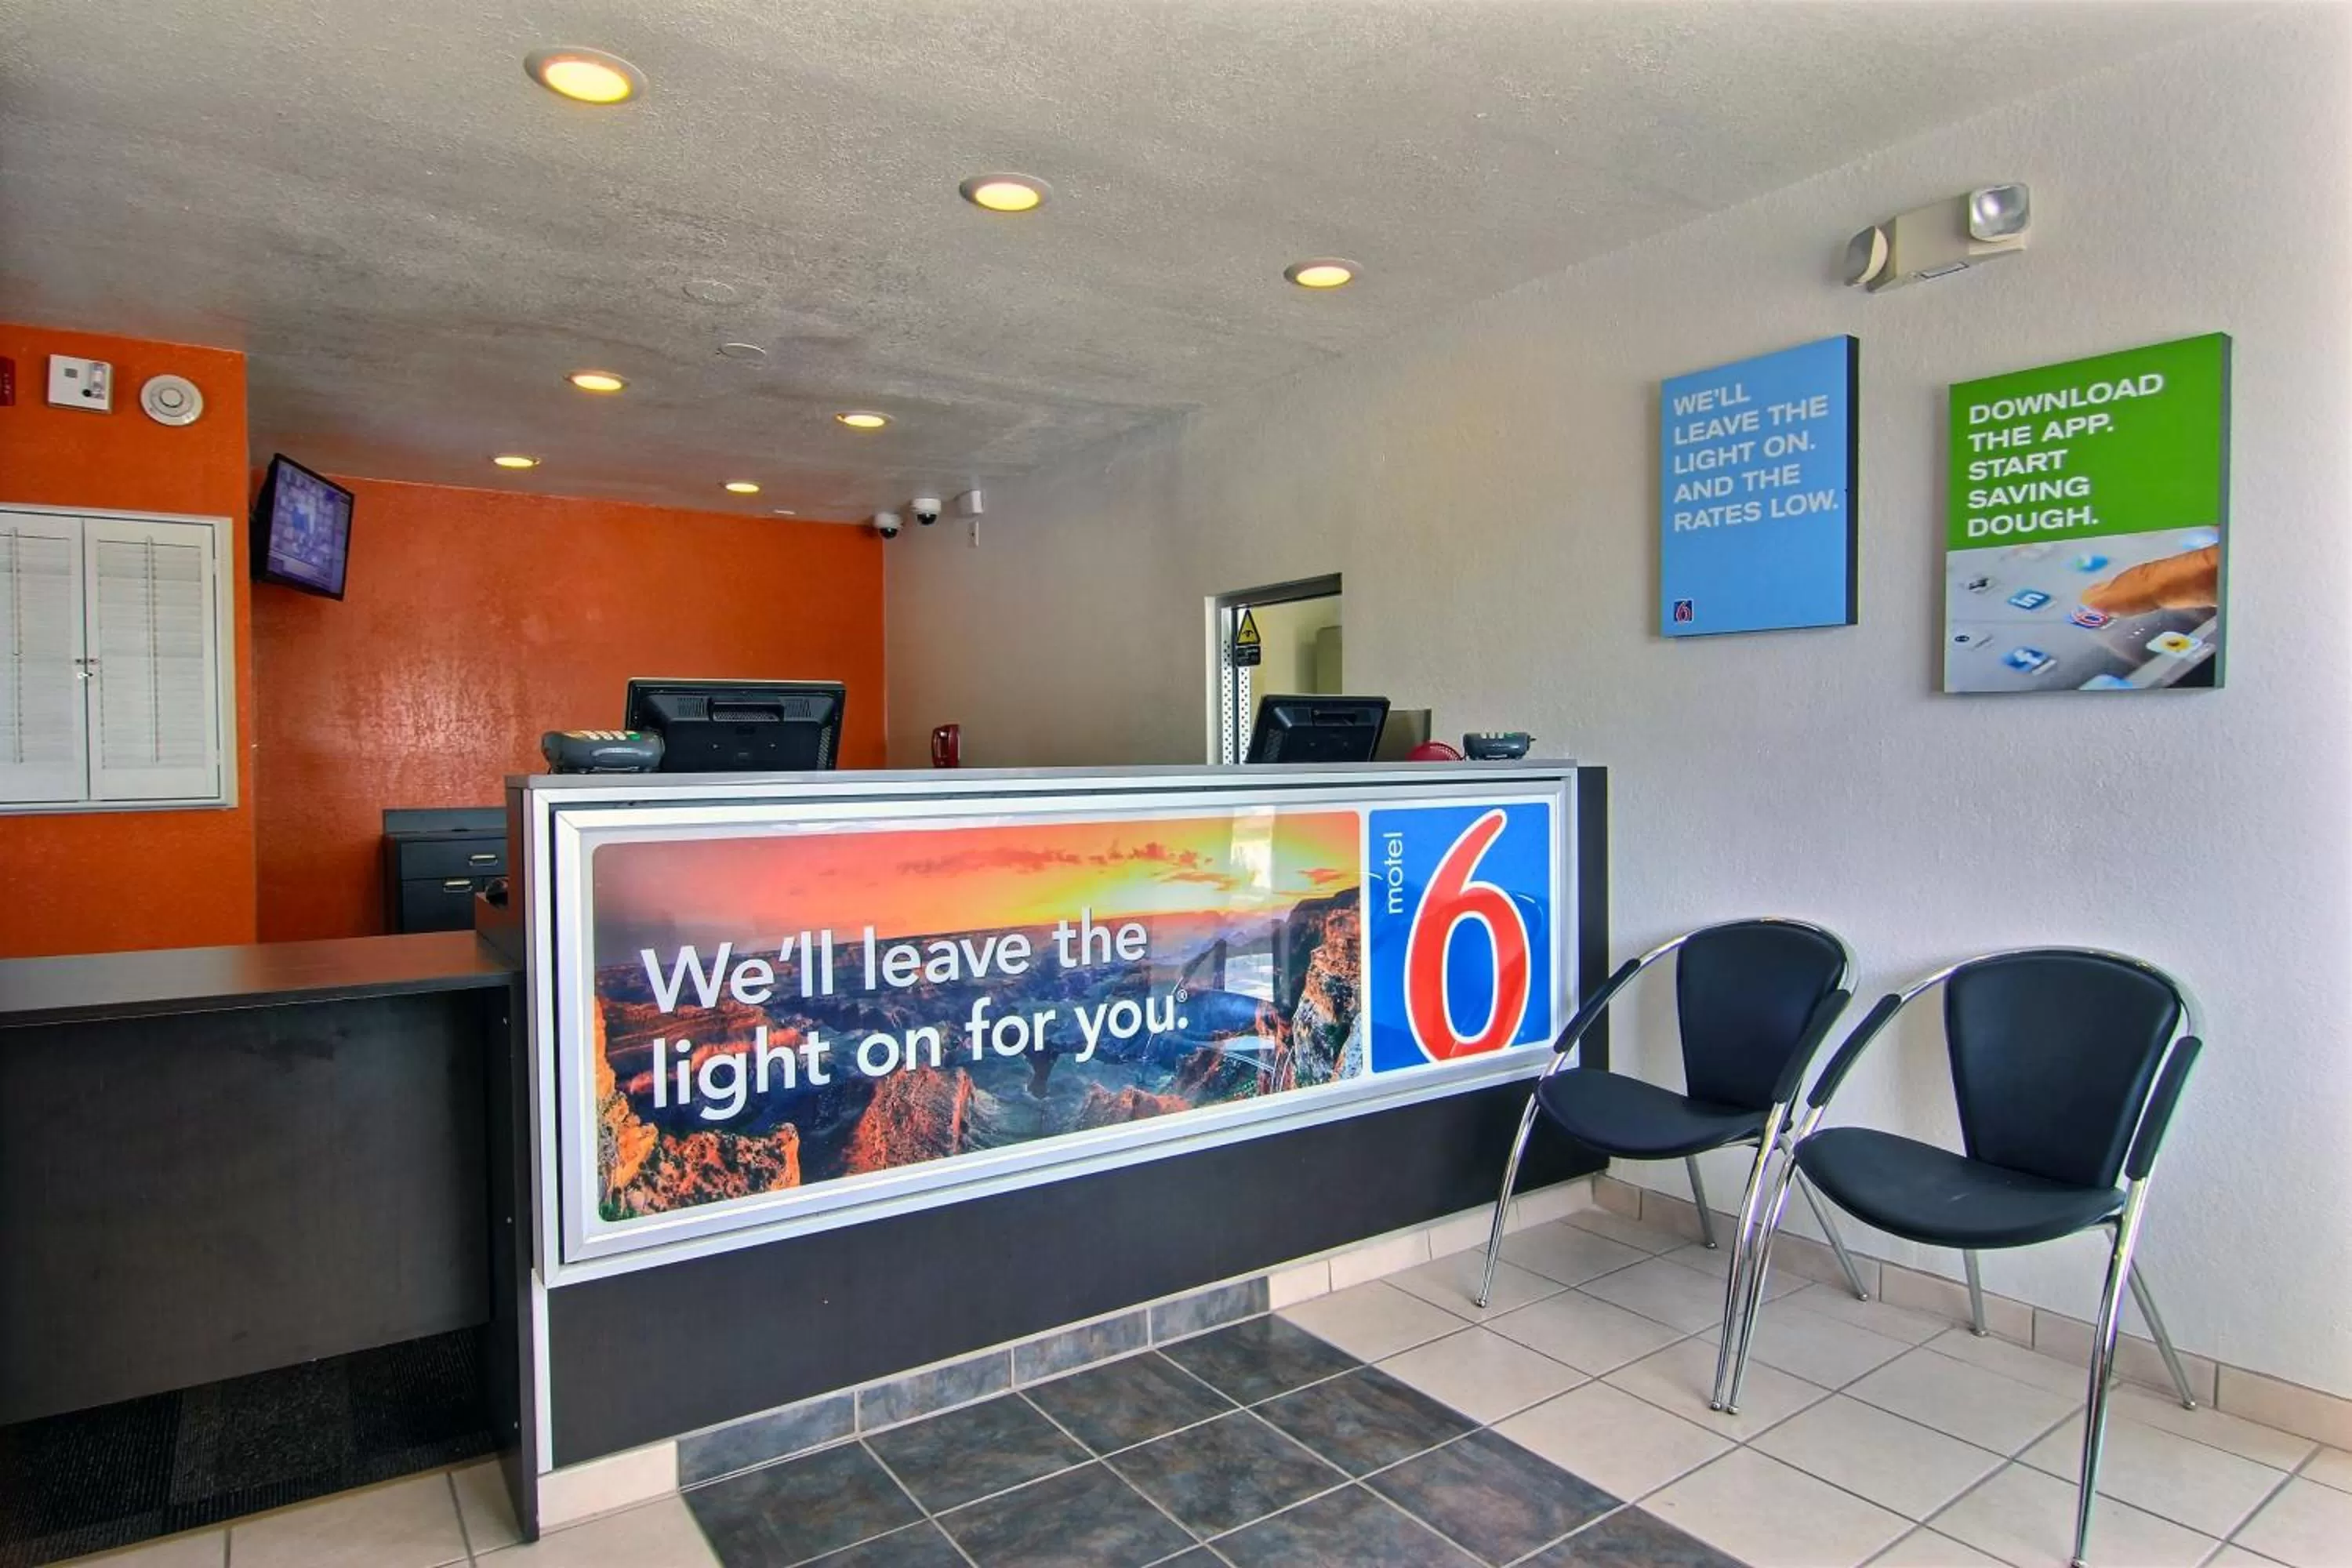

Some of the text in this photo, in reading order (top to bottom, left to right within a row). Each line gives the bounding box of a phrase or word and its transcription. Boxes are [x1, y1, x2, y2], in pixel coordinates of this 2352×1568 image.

[1673, 383, 1751, 416] WE'LL
[1674, 395, 1828, 445] LEAVE THE
[1969, 373, 2165, 425] DOWNLOAD
[1674, 430, 1816, 474] LIGHT ON.
[1968, 413, 2114, 452] THE APP.
[1673, 463, 1801, 503] AND THE
[1968, 449, 2068, 481] START
[1673, 489, 1838, 532] RATES LOW.
[1968, 476, 2090, 509] SAVING
[1967, 506, 2100, 538] DOUGH.
[1383, 832, 1403, 915] motel
[1403, 808, 1531, 1063] 6
[641, 906, 1147, 1014] We'll leave the
[653, 1027, 831, 1121] light
[856, 1025, 941, 1077] on
[965, 996, 1057, 1063] for
